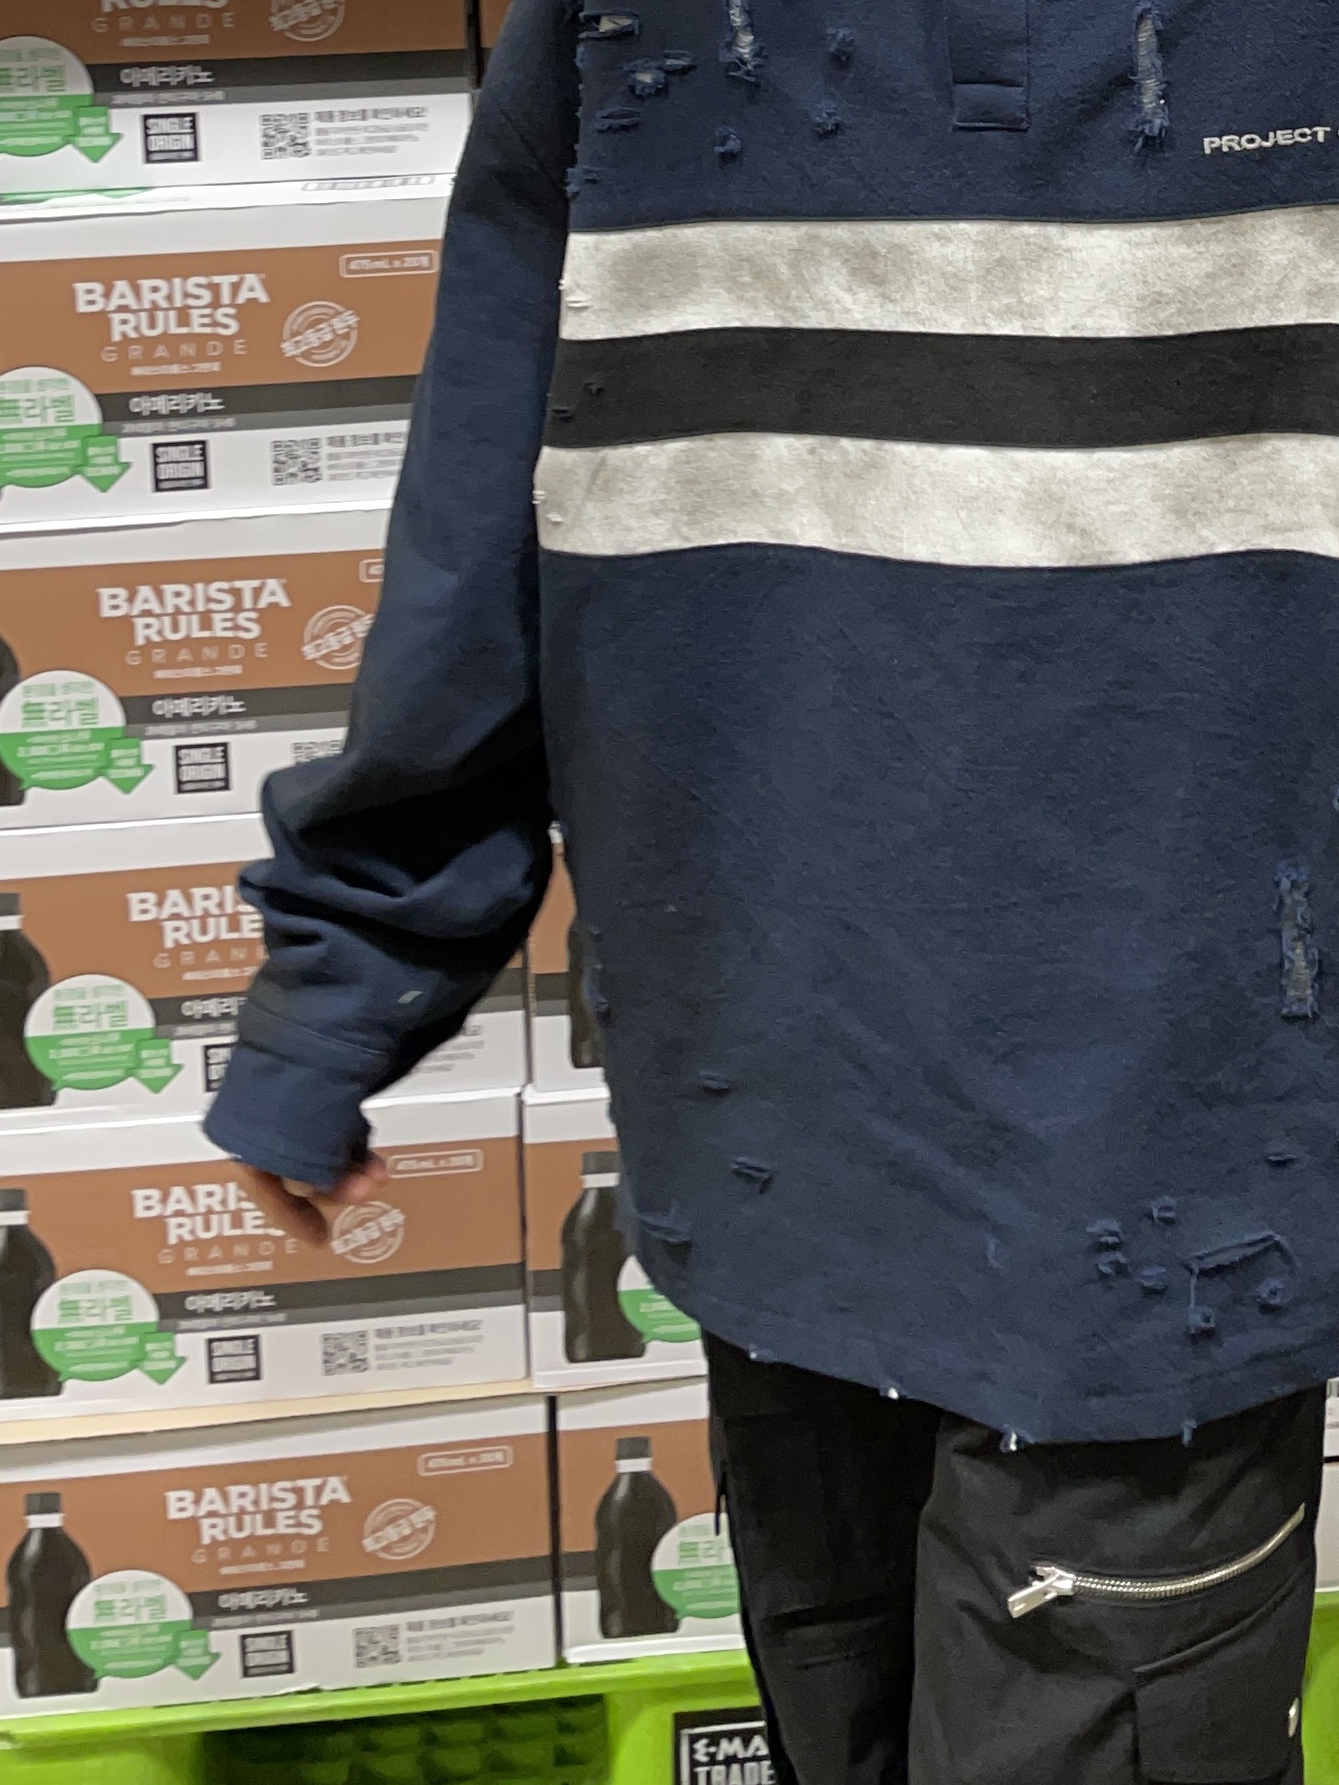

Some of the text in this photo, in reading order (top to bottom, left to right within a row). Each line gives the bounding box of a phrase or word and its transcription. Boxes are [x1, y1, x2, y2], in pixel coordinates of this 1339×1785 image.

[91, 12, 235, 33] GRANDE
[1203, 127, 1331, 154] PROJECT
[73, 273, 271, 313] BARISTA
[109, 307, 241, 342] RULES
[101, 338, 248, 363] GRANDE
[96, 578, 291, 617] BARISTA
[133, 612, 261, 647] RULES
[125, 642, 269, 666] GRANDE
[126, 885, 258, 922] BARI
[162, 914, 264, 949] RULE
[153, 947, 270, 969] GRAN
[180, 996, 248, 1019] 아메리
[158, 1238, 299, 1266] GRANDE
[164, 1476, 352, 1520] BARISTA
[200, 1511, 324, 1545] RULES
[693, 1734, 769, 1762] E-MA
[693, 1760, 776, 1785] TRADE
